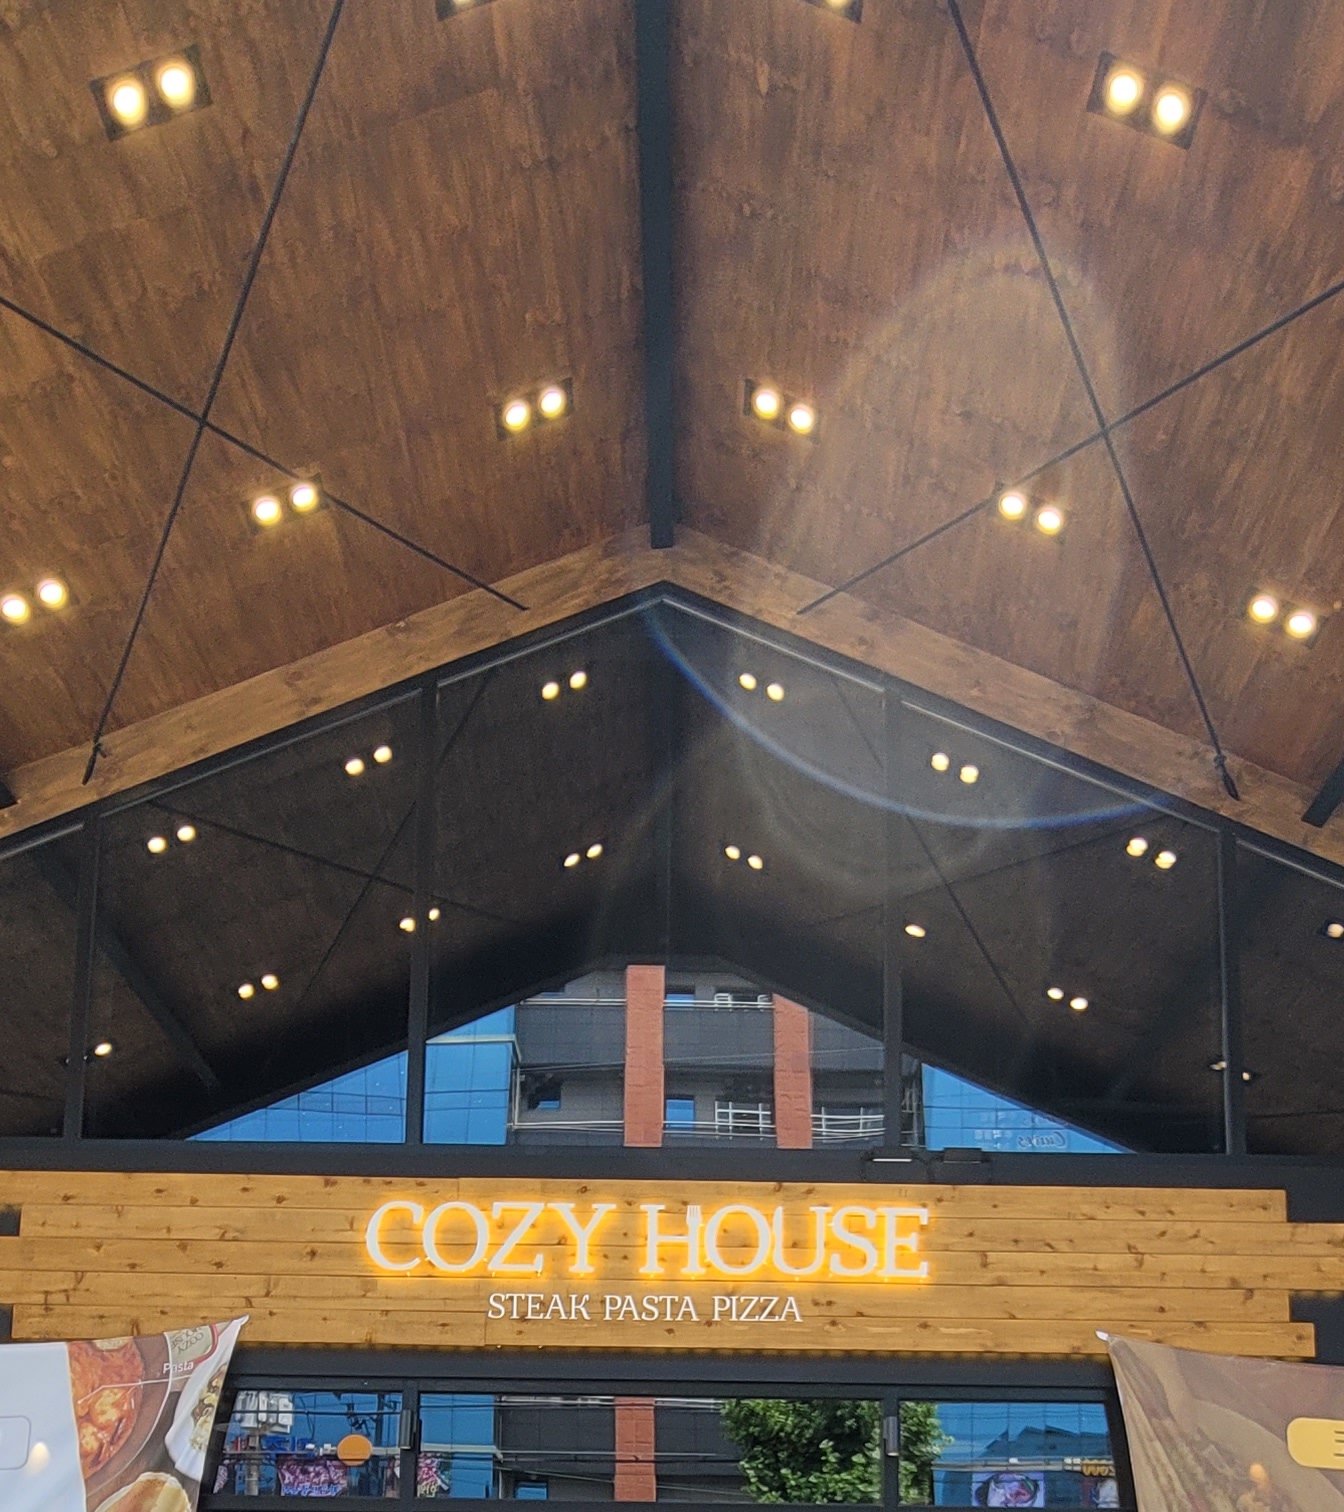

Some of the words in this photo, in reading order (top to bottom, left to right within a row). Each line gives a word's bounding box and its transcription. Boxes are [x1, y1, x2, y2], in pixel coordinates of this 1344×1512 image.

[366, 1201, 617, 1274] COZY
[639, 1204, 929, 1279] HOUSE
[487, 1292, 590, 1321] STEAK
[603, 1294, 700, 1322] PASTA
[712, 1296, 803, 1323] PIZZA
[163, 1361, 194, 1374] Pasta
